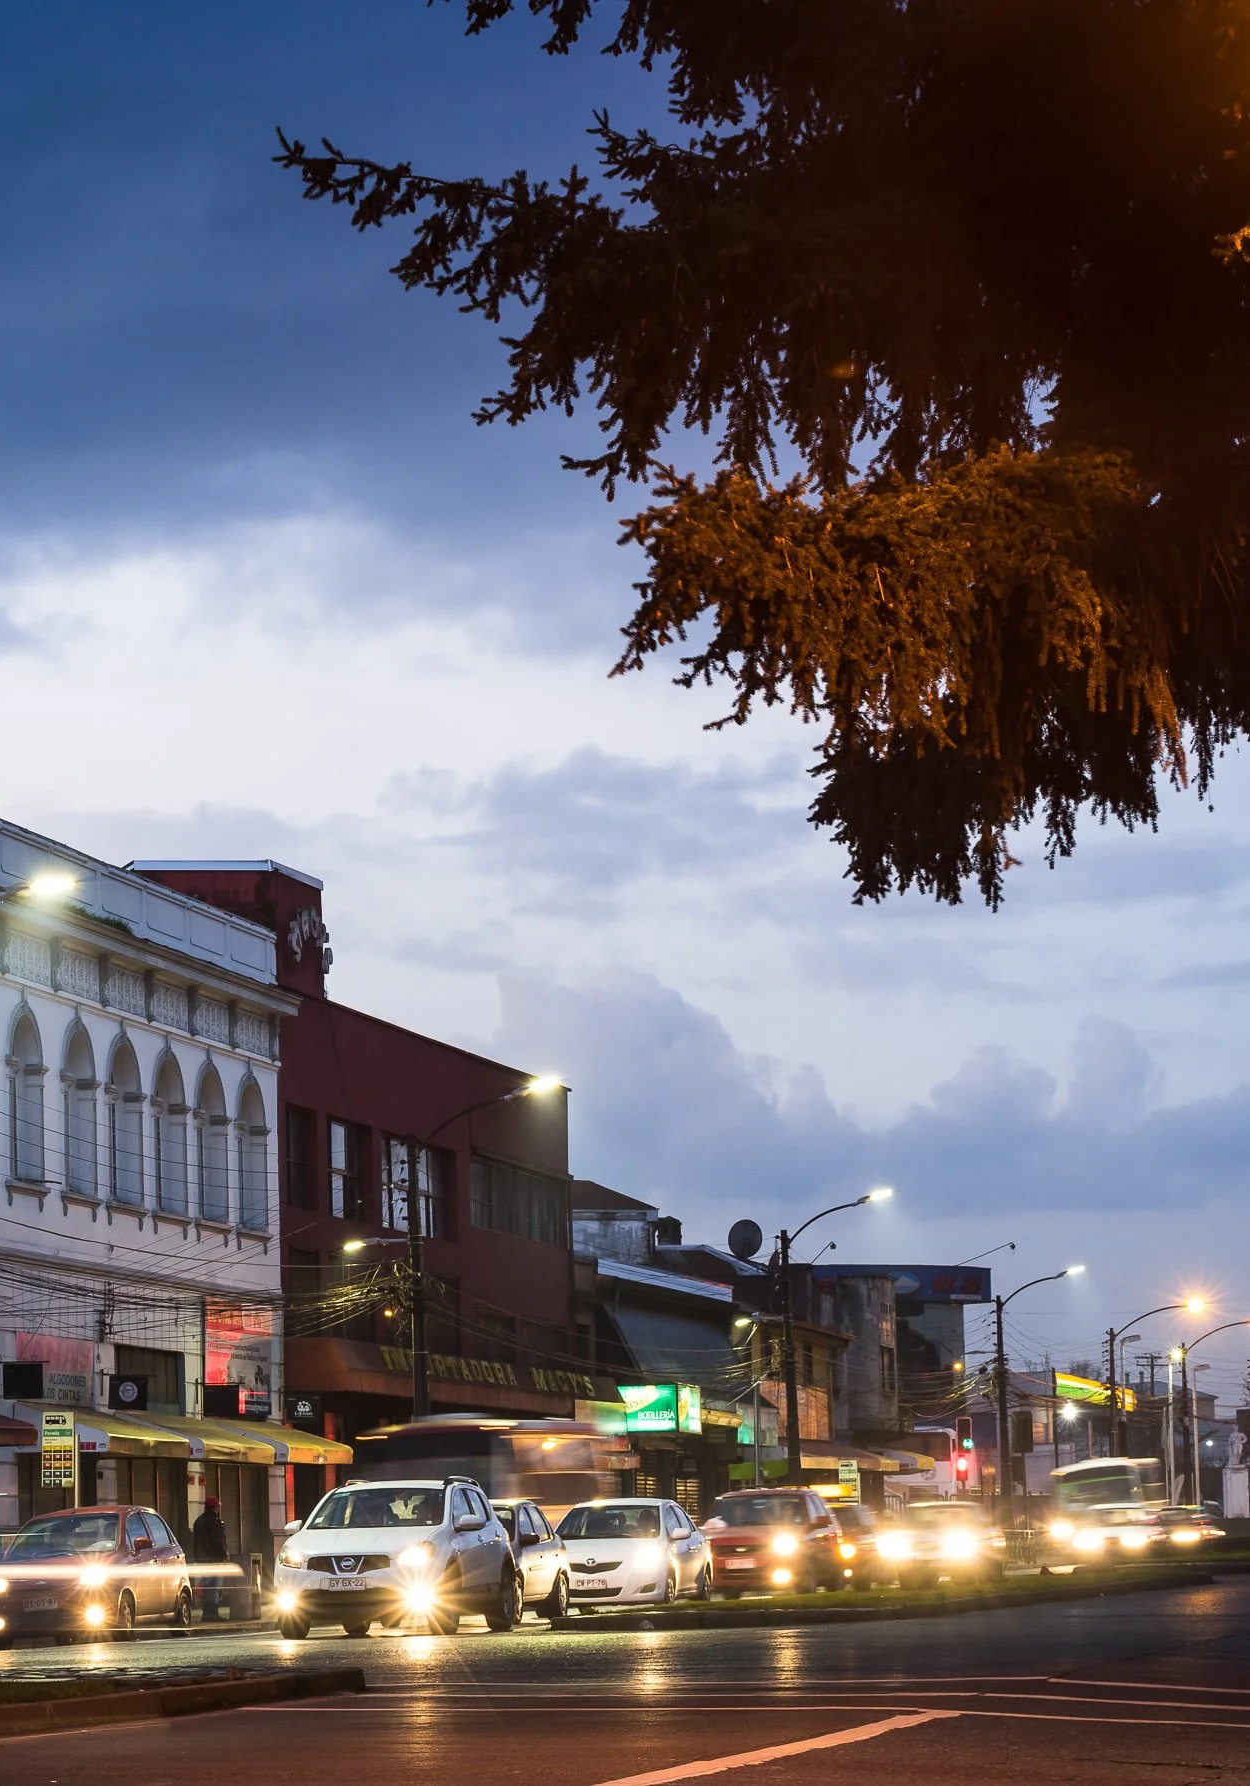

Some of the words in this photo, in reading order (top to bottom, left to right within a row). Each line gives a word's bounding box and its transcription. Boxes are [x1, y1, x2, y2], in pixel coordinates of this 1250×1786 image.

[49, 1373, 87, 1388] ALGODONES
[529, 1367, 596, 1397] MACY'S
[58, 1388, 81, 1402] CINTAS
